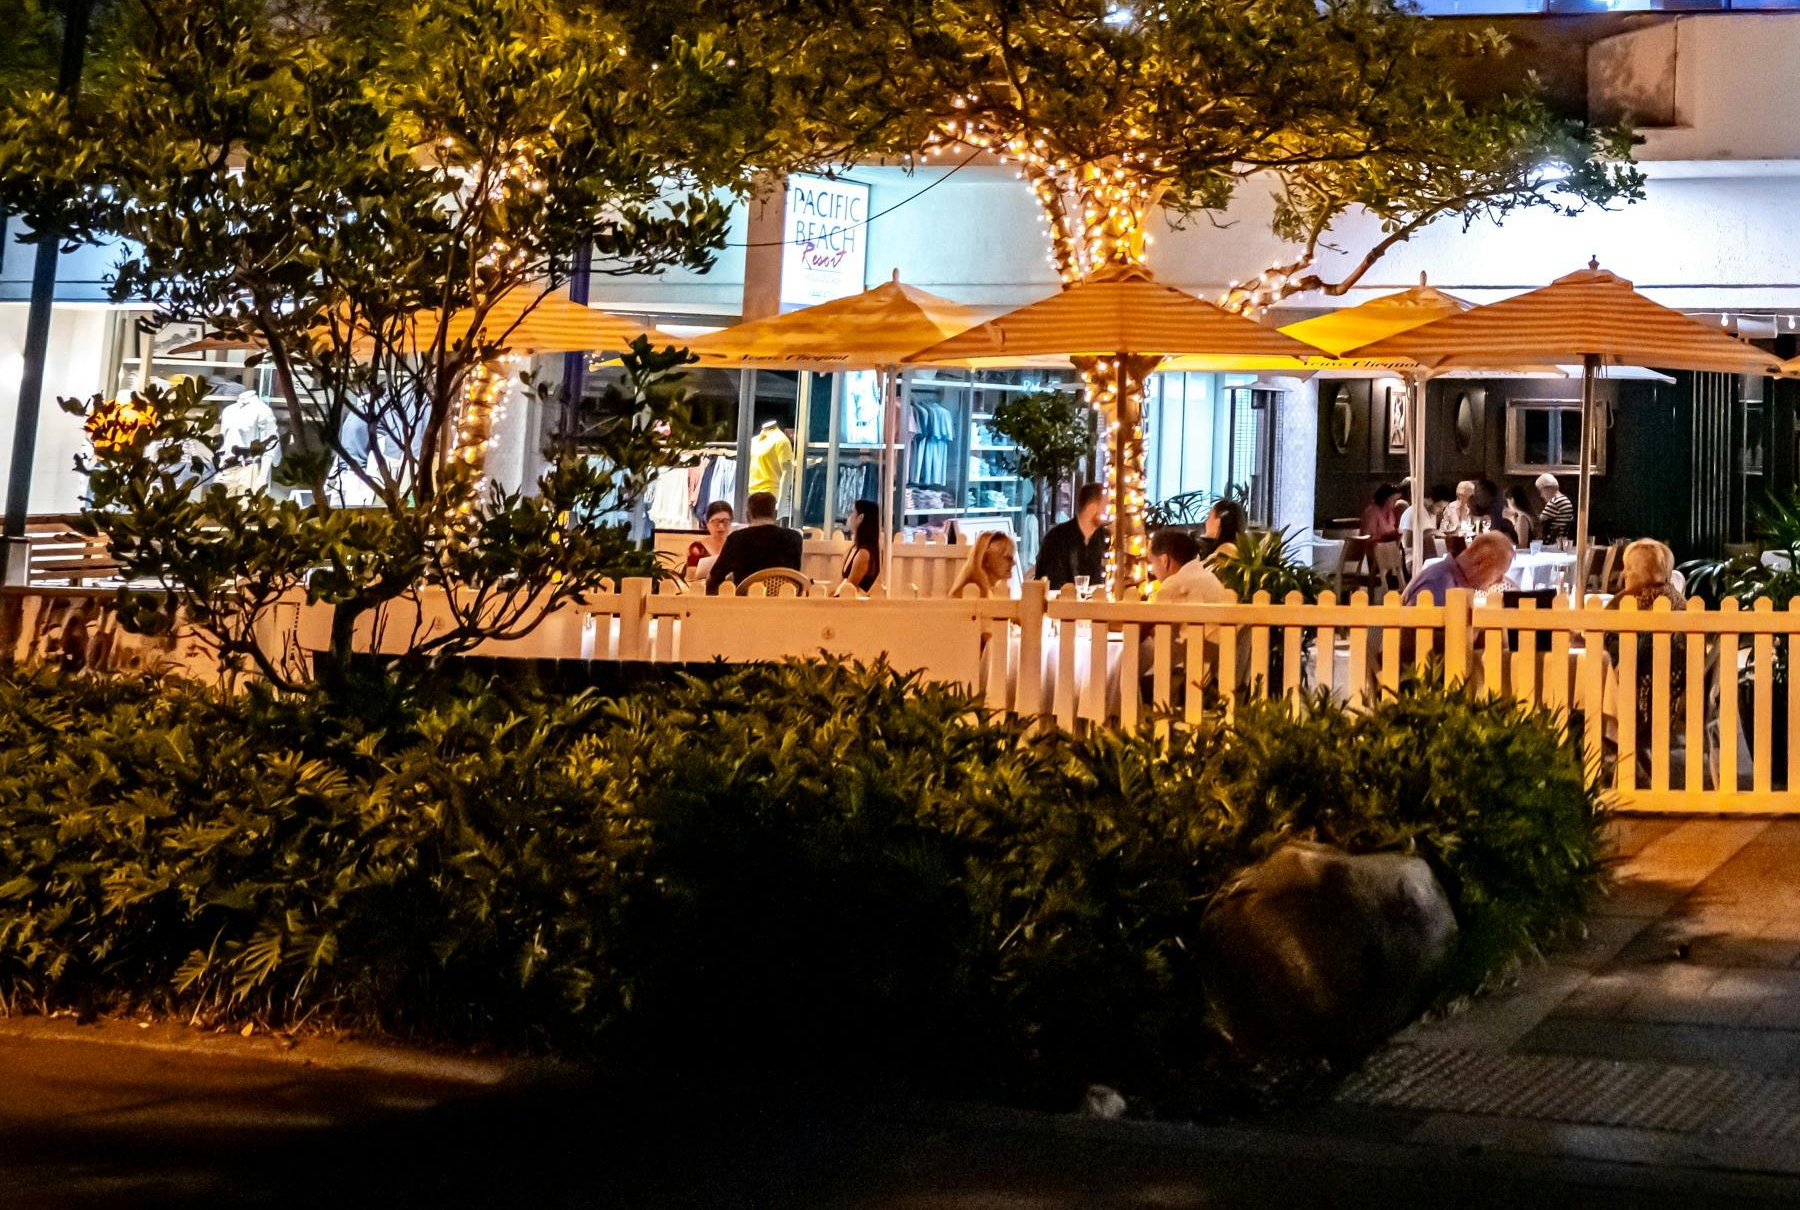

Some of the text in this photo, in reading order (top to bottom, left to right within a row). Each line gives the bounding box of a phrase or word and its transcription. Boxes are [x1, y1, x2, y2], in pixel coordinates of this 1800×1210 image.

[793, 187, 860, 222] PACIFIC
[796, 220, 855, 252] BEACH
[801, 241, 847, 270] Resort
